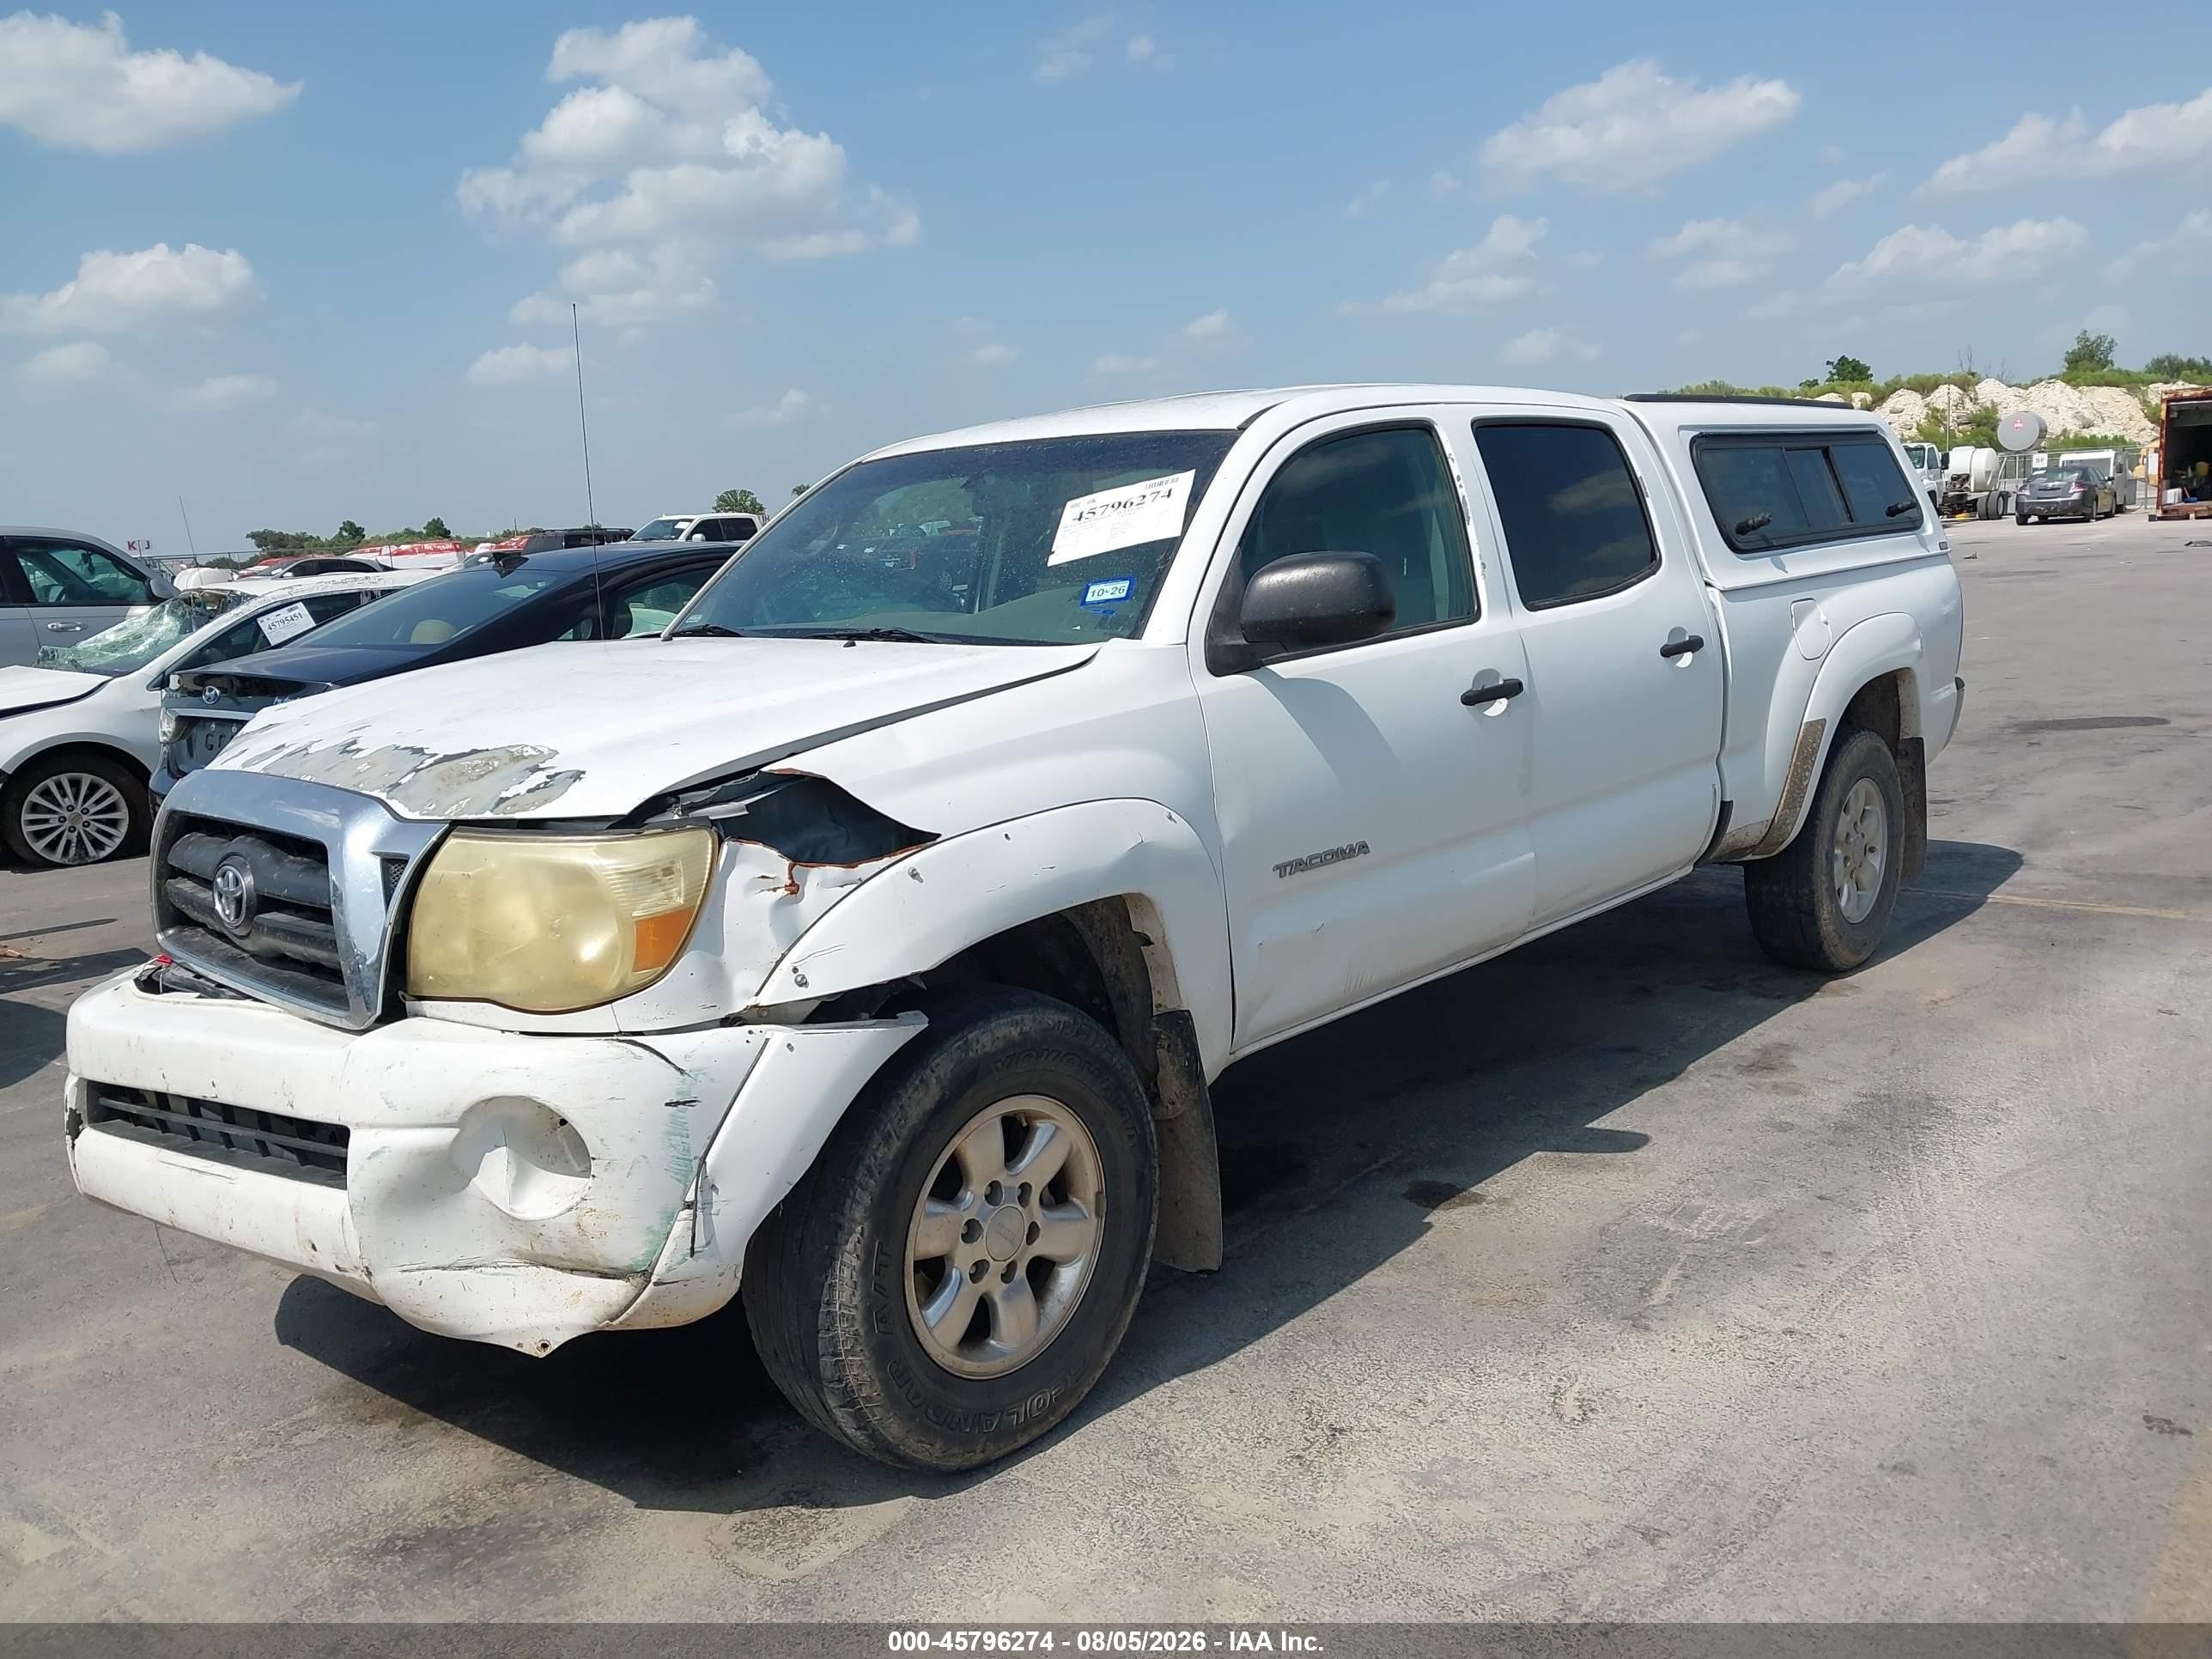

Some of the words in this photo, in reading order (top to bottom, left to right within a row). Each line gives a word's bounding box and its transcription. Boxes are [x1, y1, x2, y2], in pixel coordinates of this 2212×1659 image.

[1073, 488, 1173, 521] 45796274
[127, 540, 137, 550] K
[144, 540, 150, 550] J
[1273, 841, 1370, 878] TACOMA
